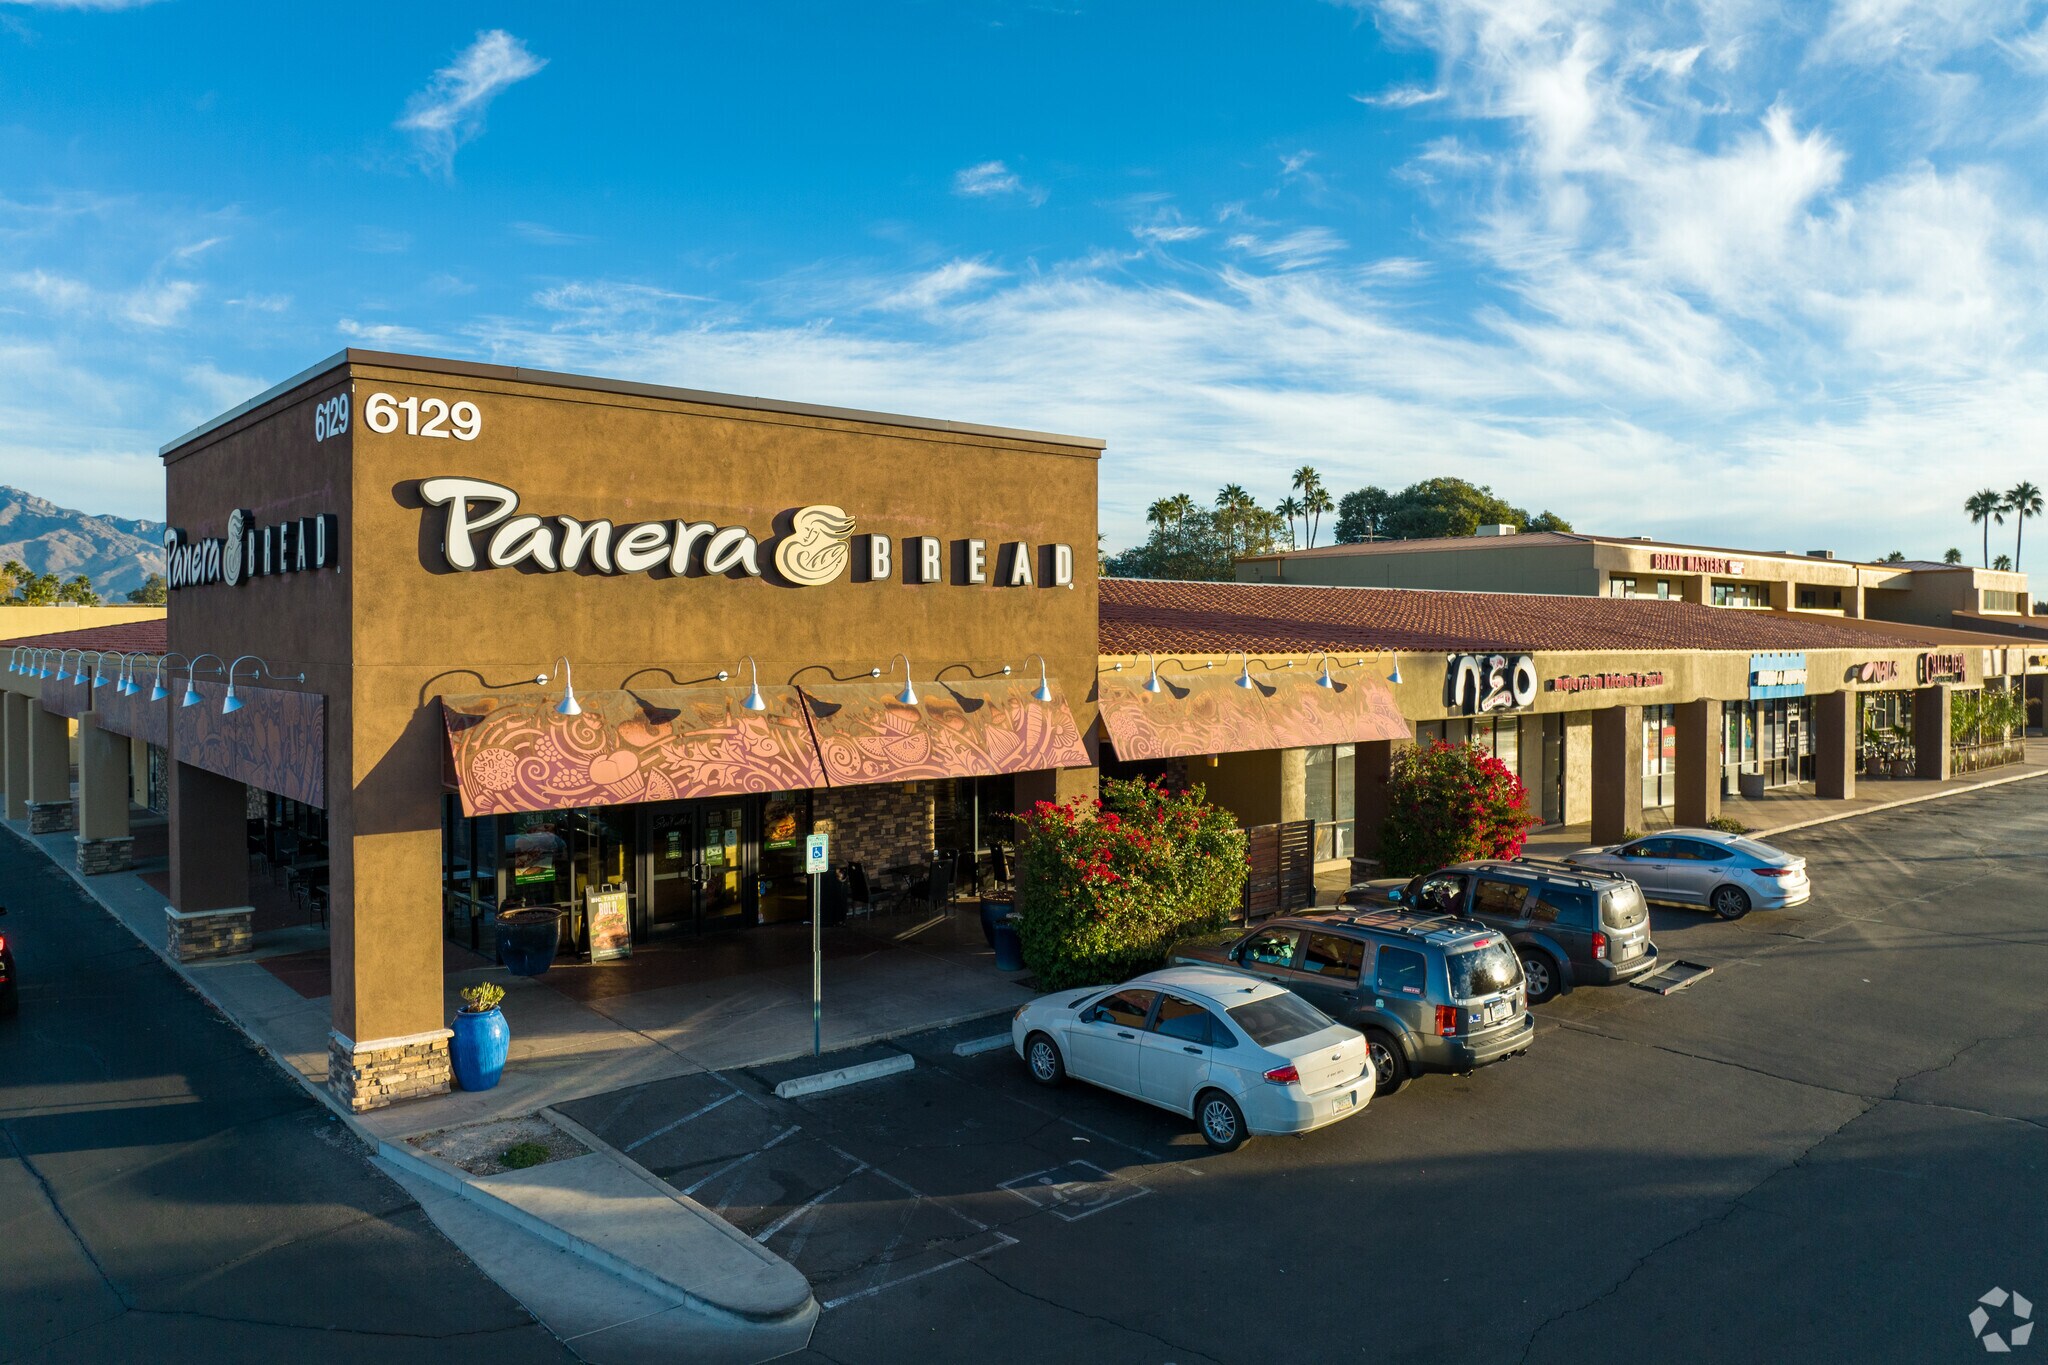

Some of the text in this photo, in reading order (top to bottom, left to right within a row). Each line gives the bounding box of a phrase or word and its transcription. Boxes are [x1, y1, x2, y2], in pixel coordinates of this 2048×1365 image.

[315, 393, 349, 442] 6129
[364, 392, 482, 441] 6129
[163, 513, 326, 590] Panera BREAD
[418, 476, 1074, 586] Panera BREAD
[1872, 660, 1899, 683] NAILS
